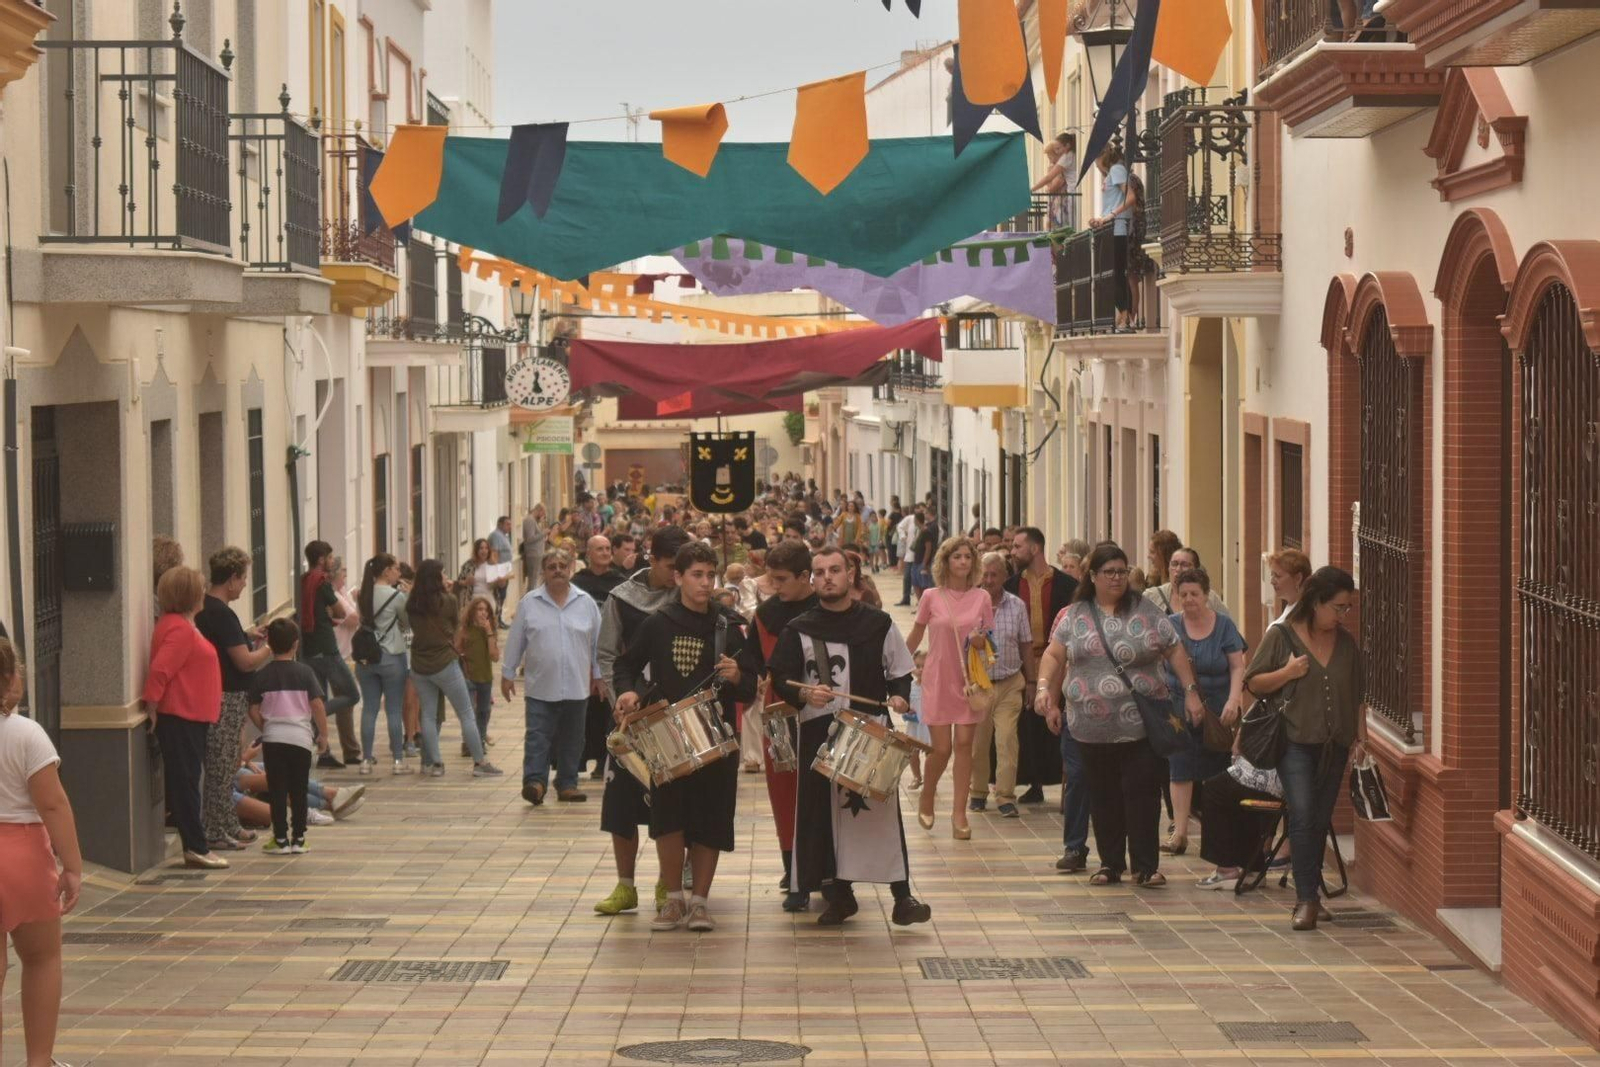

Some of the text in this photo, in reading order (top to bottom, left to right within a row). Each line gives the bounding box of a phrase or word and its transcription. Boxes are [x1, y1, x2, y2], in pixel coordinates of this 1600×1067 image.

[507, 357, 570, 384] MODA FLAMENCA
[521, 396, 554, 406] ALPE
